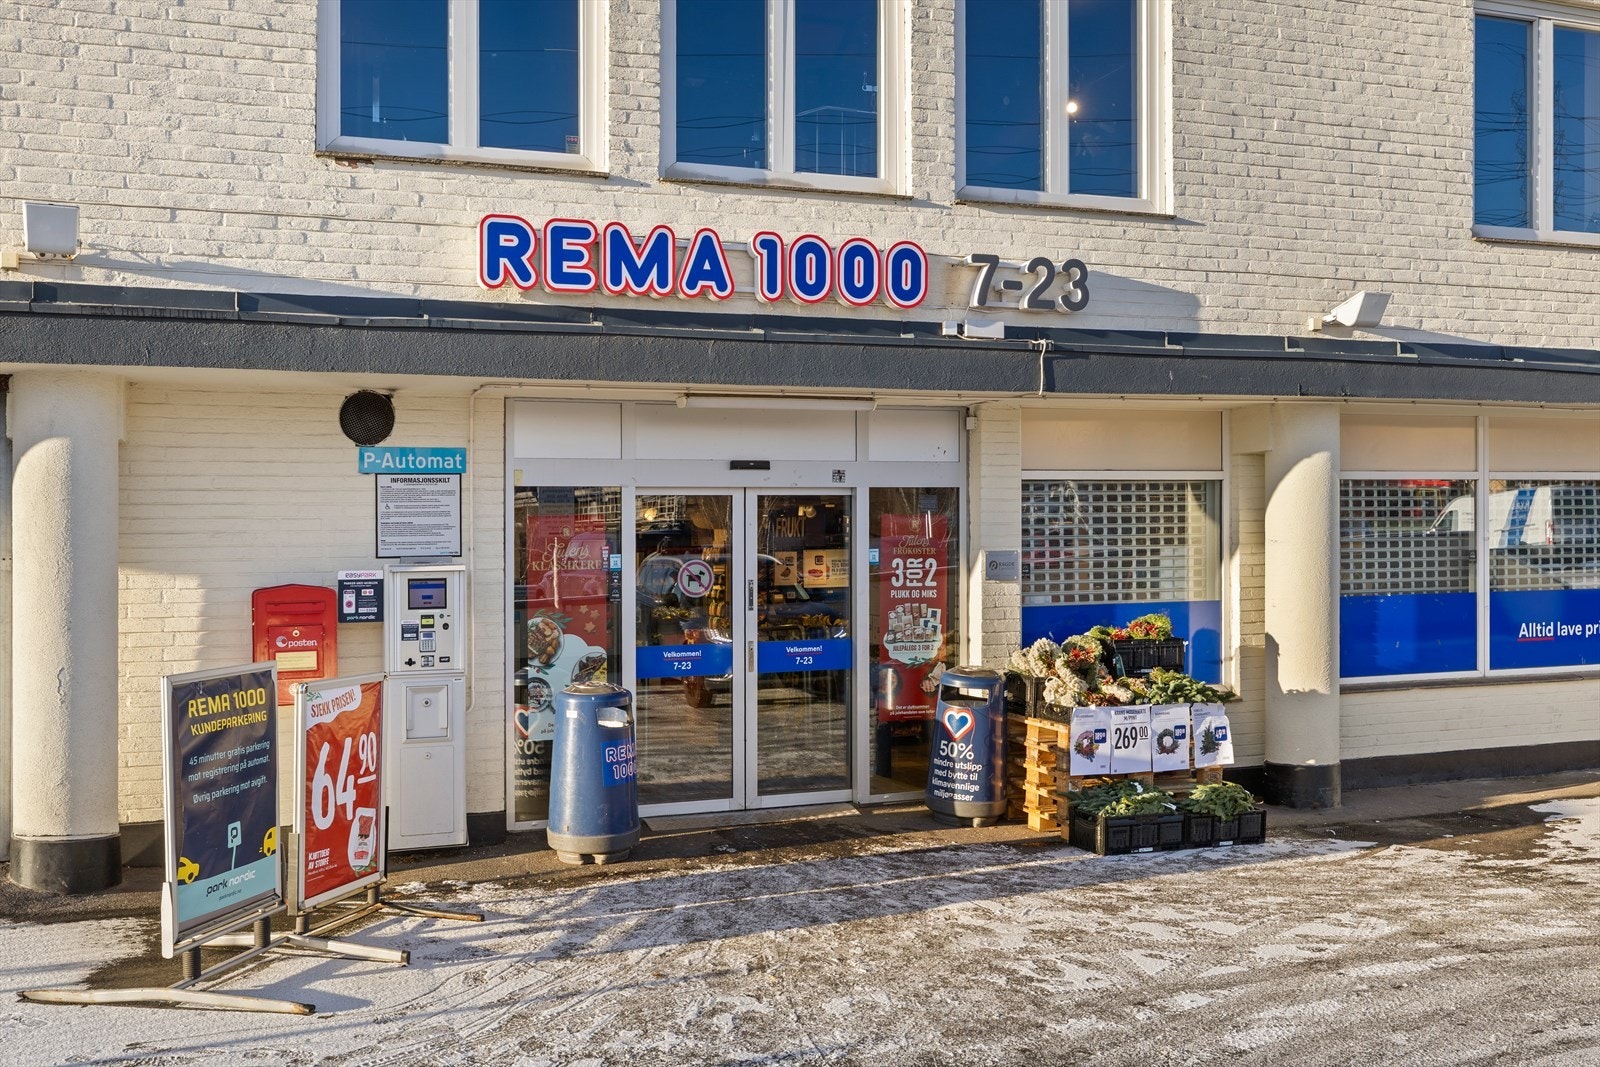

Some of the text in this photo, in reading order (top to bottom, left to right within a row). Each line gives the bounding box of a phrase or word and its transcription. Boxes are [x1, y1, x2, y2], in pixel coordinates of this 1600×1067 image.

[478, 213, 929, 308] REMA 1000
[965, 253, 1091, 312] 7-23
[363, 452, 463, 469] P-Automat
[776, 517, 806, 538] FRUKT
[899, 534, 930, 548] Julens
[541, 542, 592, 562] Julens
[531, 559, 602, 571] KLASSIKERE
[891, 557, 938, 588] 3 FOR 2
[890, 590, 938, 599] PLUKK OG MIKS
[1518, 622, 1554, 638] Alltid
[1557, 621, 1582, 637] lave
[288, 639, 318, 648] posten
[785, 645, 823, 653] Velkommen!
[663, 650, 702, 658] Velkommen!
[795, 656, 813, 665] 7-23
[673, 661, 692, 670] 7-23
[188, 687, 266, 718] REMA 1000
[310, 688, 357, 718] SJEKK PRISEN!
[190, 710, 267, 736] KUNDEPARKERING
[1114, 726, 1149, 750] 269 00
[188, 740, 270, 766] 45 minutter gratis parkering
[940, 740, 975, 760] 50%
[188, 754, 270, 783] mot registrering på automat.
[933, 757, 983, 772] mindre utslipp
[934, 767, 978, 781] med bytte til
[192, 774, 268, 805] Øvrig parkering mot avgift.
[311, 731, 377, 830] 64 90
[931, 776, 980, 792] klimavennlige
[205, 869, 257, 898] park nordic
